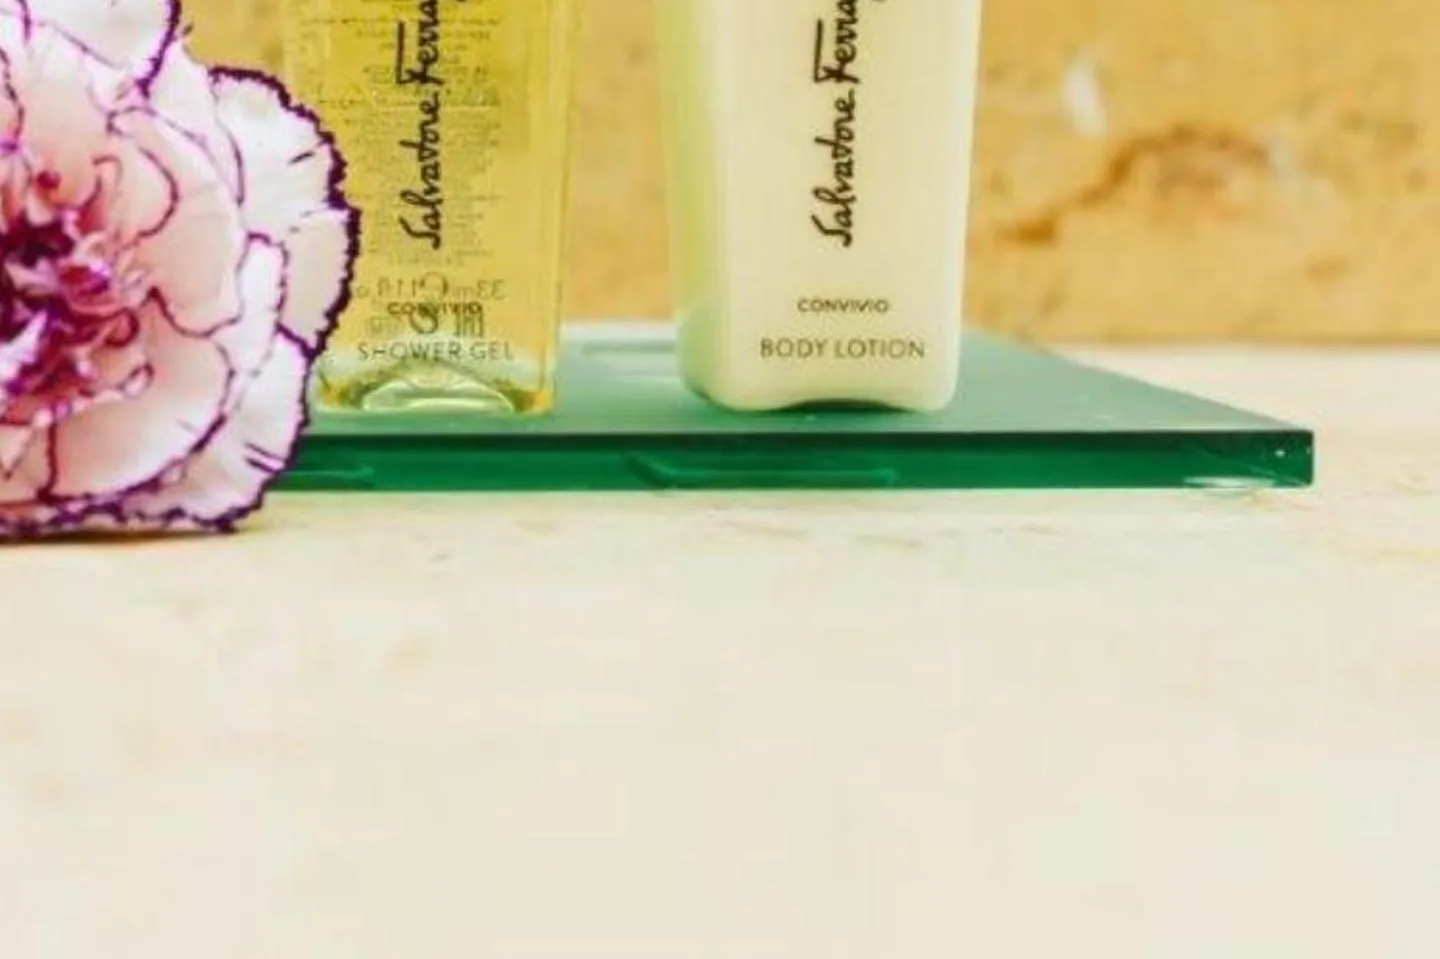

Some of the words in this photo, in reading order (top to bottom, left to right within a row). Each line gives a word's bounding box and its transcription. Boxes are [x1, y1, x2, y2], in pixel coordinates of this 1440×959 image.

[399, 91, 444, 250] Salvatore
[811, 89, 856, 247] Salvatore
[797, 298, 889, 313] CONVIVIO
[358, 341, 461, 361] SHOWER
[468, 340, 515, 361] GEL
[760, 339, 827, 359] BODY
[833, 339, 925, 359] LOTION
